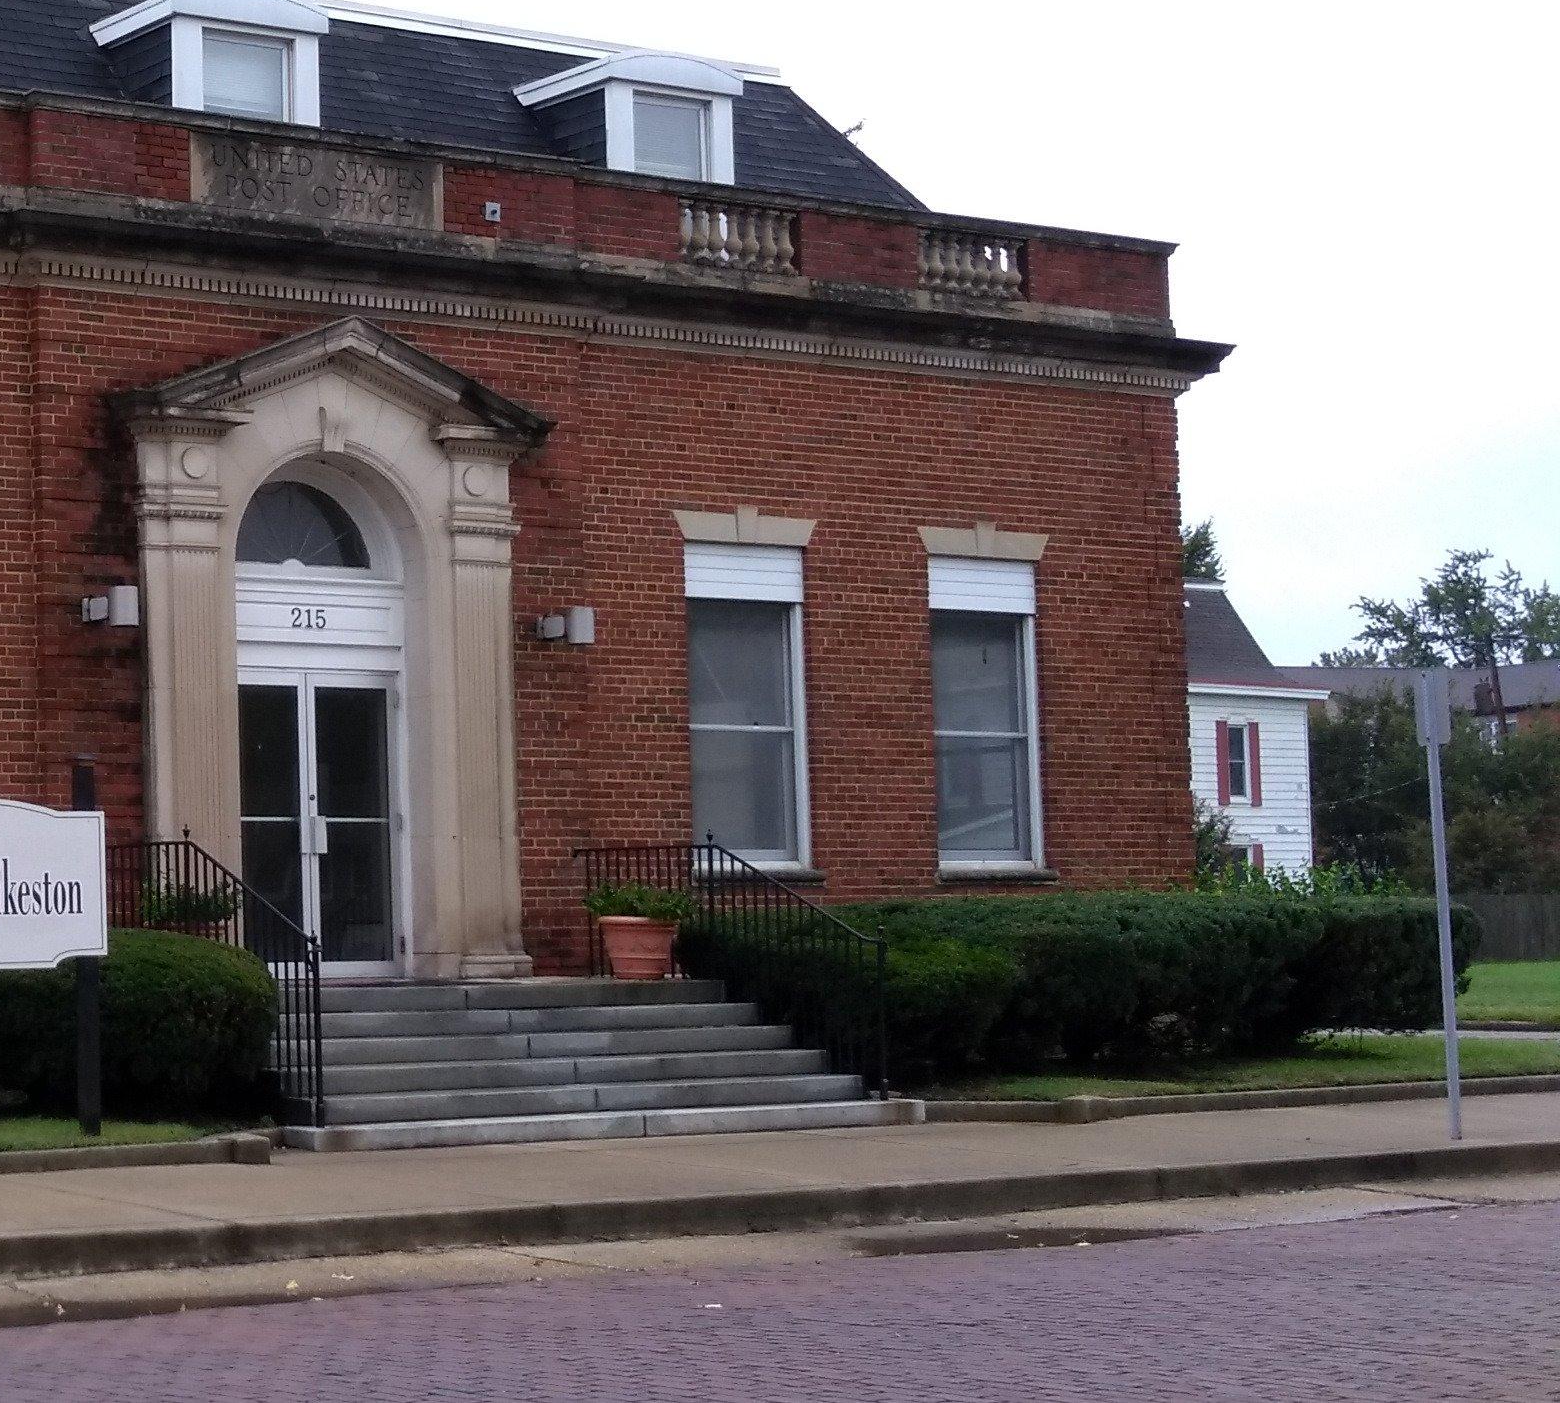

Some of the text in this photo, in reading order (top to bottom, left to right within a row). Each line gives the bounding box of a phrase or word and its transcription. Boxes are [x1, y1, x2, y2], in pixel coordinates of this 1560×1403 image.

[210, 144, 425, 192] UNITED STATES
[224, 174, 412, 218] POST OFFICE
[290, 607, 327, 630] 215
